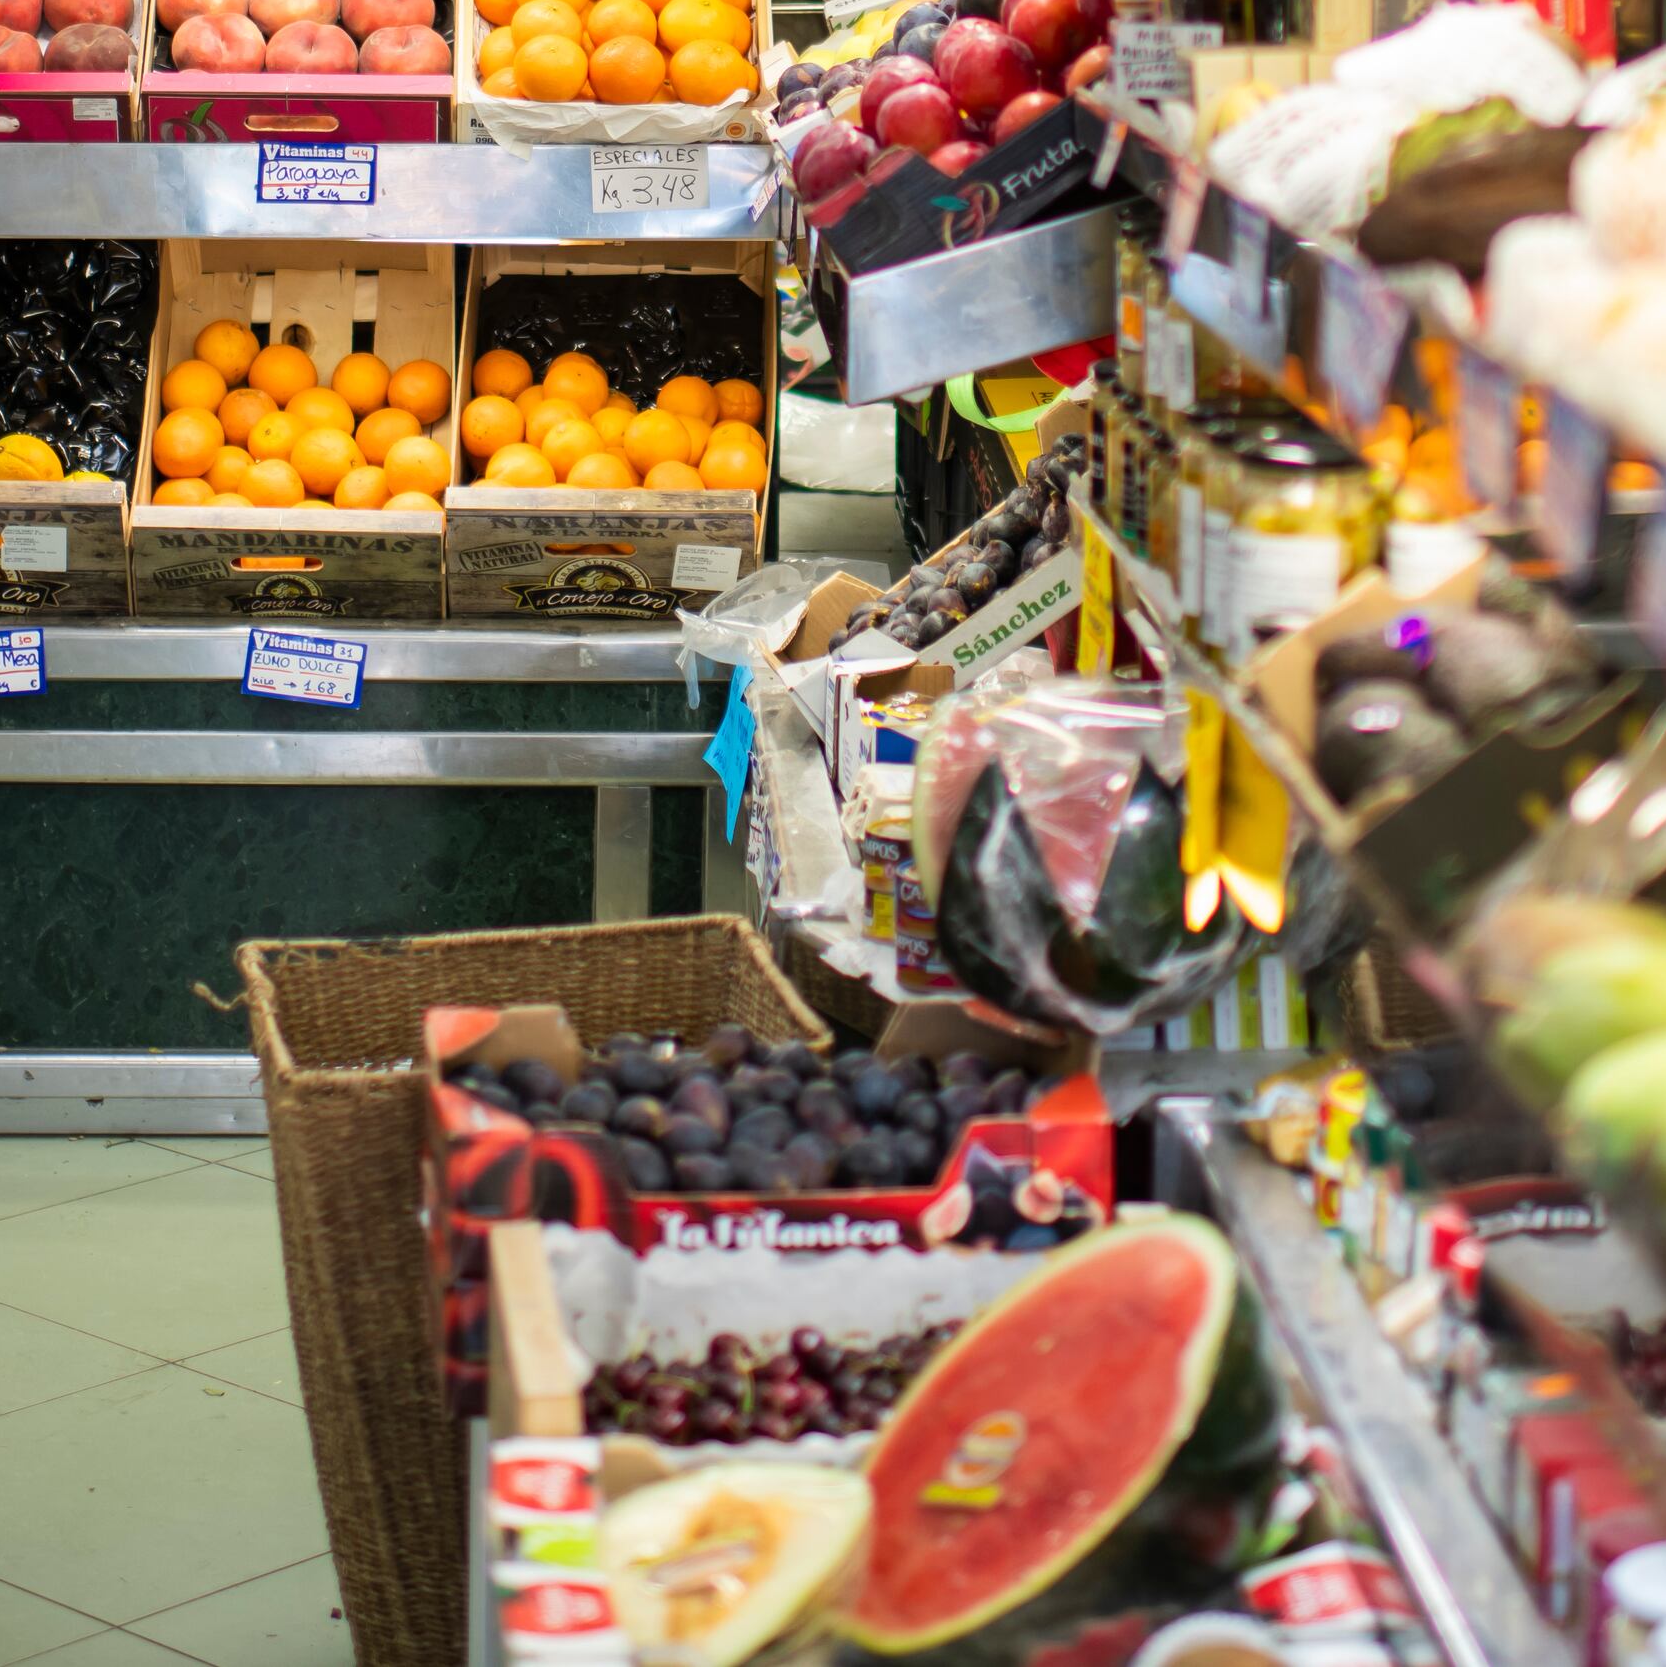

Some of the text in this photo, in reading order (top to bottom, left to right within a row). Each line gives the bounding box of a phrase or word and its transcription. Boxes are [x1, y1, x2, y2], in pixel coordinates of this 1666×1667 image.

[263, 143, 368, 161] Vitaminas 44
[593, 148, 699, 165] ESPECIALES
[265, 161, 359, 188] Paraguaya
[1002, 138, 1083, 200] Fruta
[598, 529, 668, 539] TIERRA
[157, 534, 416, 554] MANDARINAS
[465, 543, 536, 562] VITAMINA
[160, 561, 221, 580] VITAMINA
[470, 552, 538, 572] NATURAL
[1, 586, 41, 603] Oro
[547, 591, 614, 609] Conejo
[629, 592, 668, 609] Oro
[552, 607, 646, 618] VILLACONEJOS
[952, 579, 1072, 669] Sánchez
[253, 632, 333, 655] Vitaminas
[2, 651, 39, 668] Mesa
[254, 652, 344, 674] ZUMO DULCE
